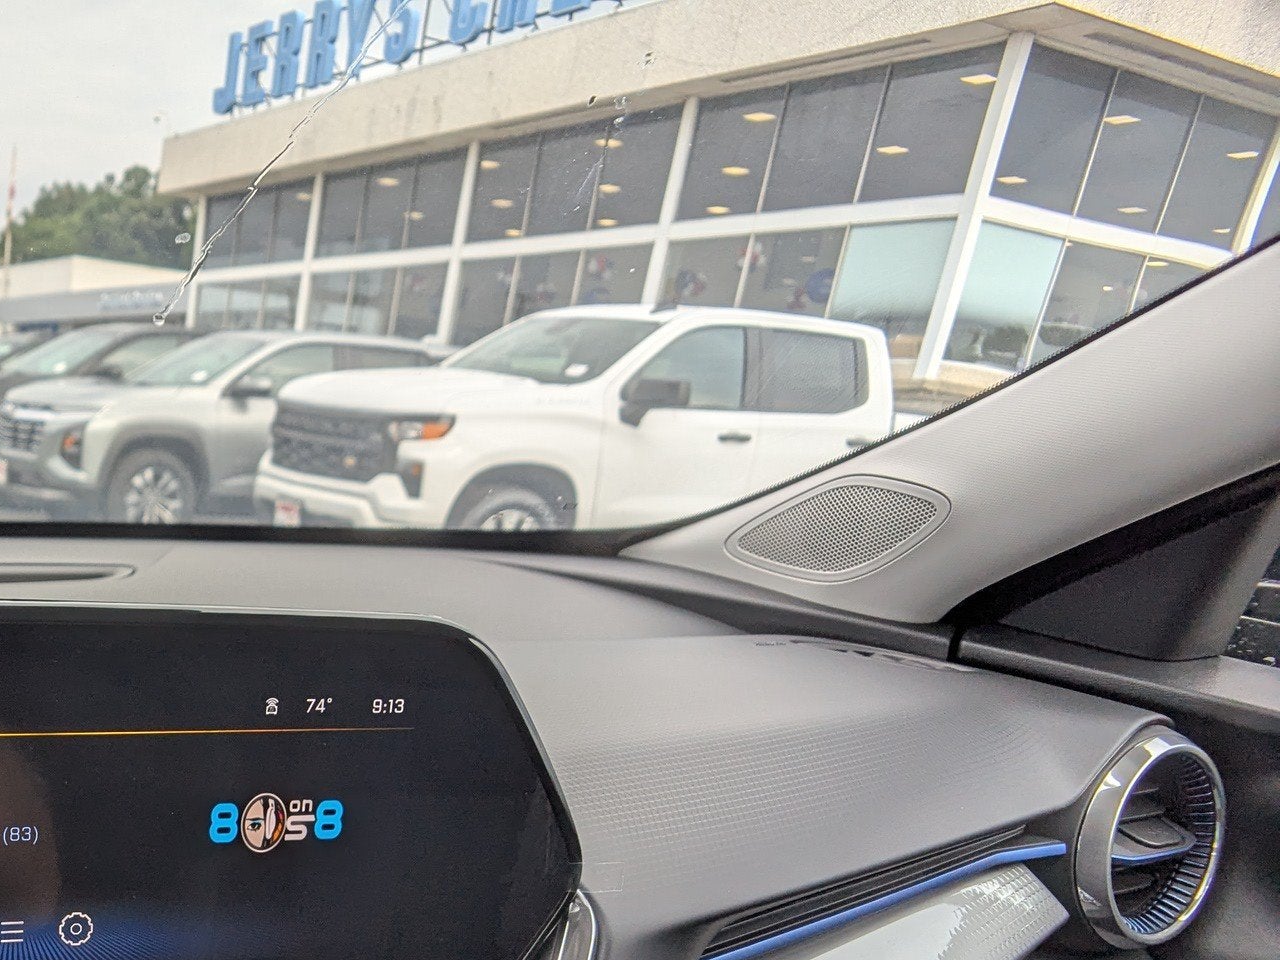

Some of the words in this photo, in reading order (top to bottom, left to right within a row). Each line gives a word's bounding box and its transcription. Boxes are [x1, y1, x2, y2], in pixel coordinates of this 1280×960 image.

[372, 698, 405, 714] 9:13
[289, 799, 313, 812] on
[314, 799, 344, 840] 8
[3, 826, 39, 846] (83)
